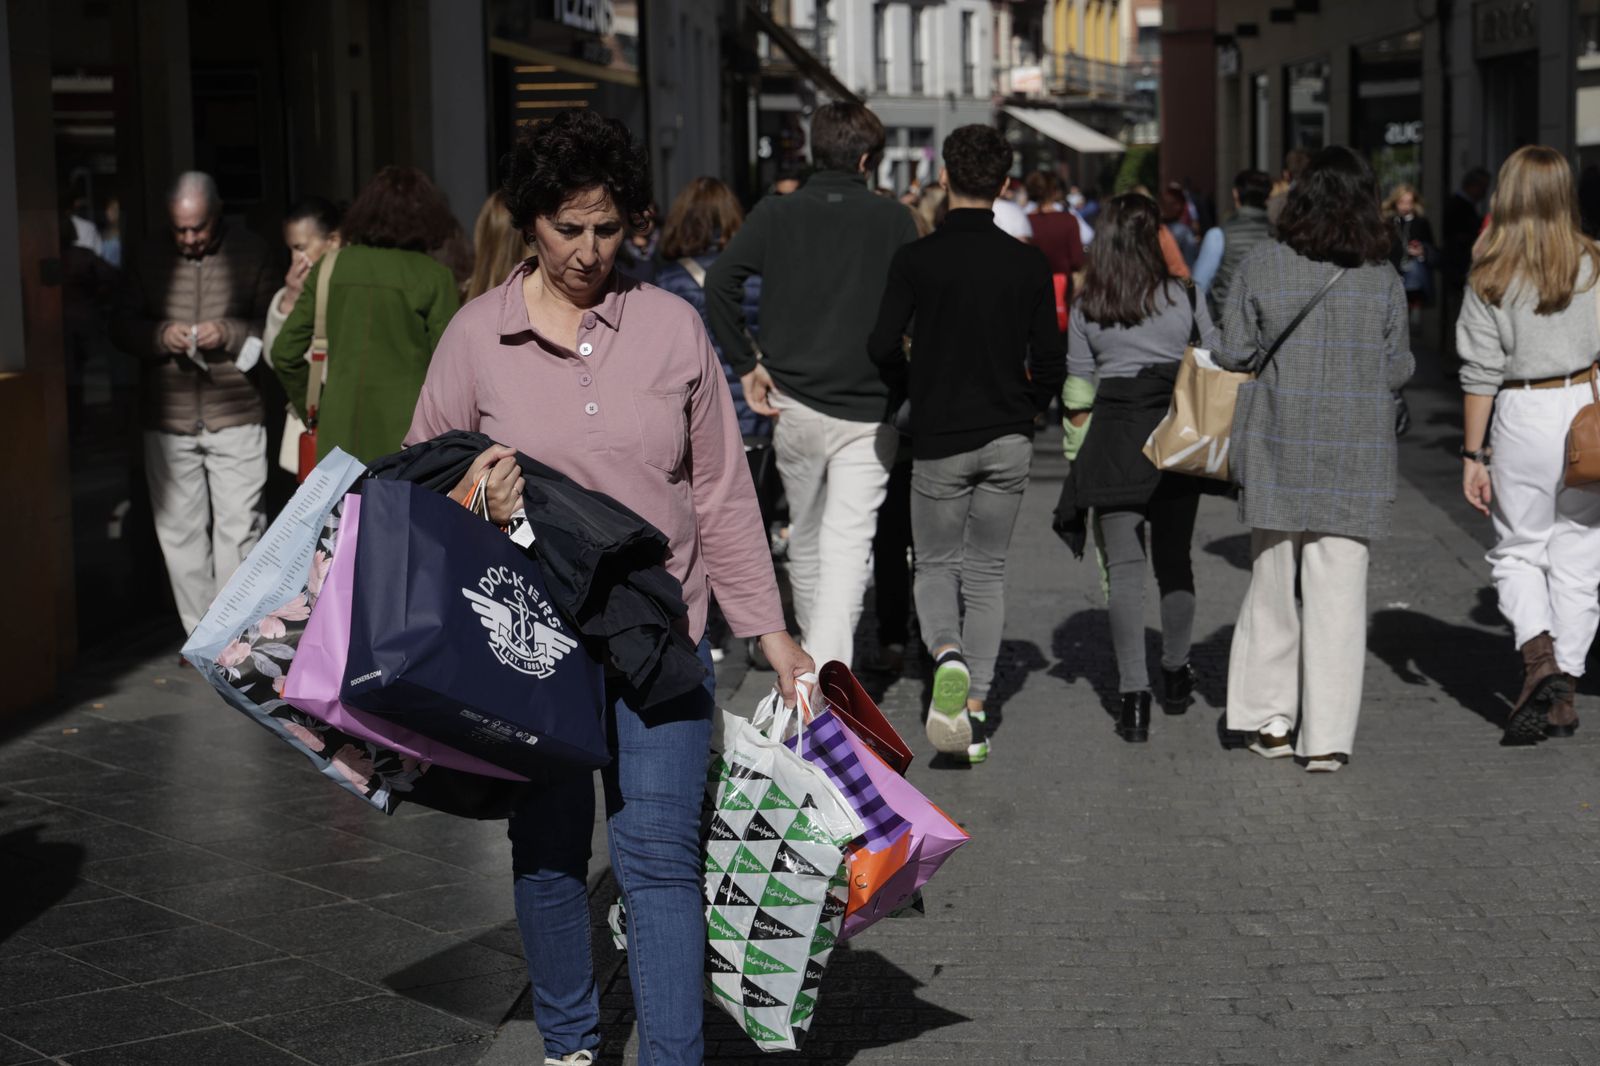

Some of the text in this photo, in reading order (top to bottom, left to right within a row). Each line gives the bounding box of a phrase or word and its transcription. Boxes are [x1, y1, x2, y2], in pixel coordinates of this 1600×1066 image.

[478, 566, 561, 628] DOCKERS
[505, 650, 520, 666] EST.
[350, 670, 382, 686] DOCKERS.COM
